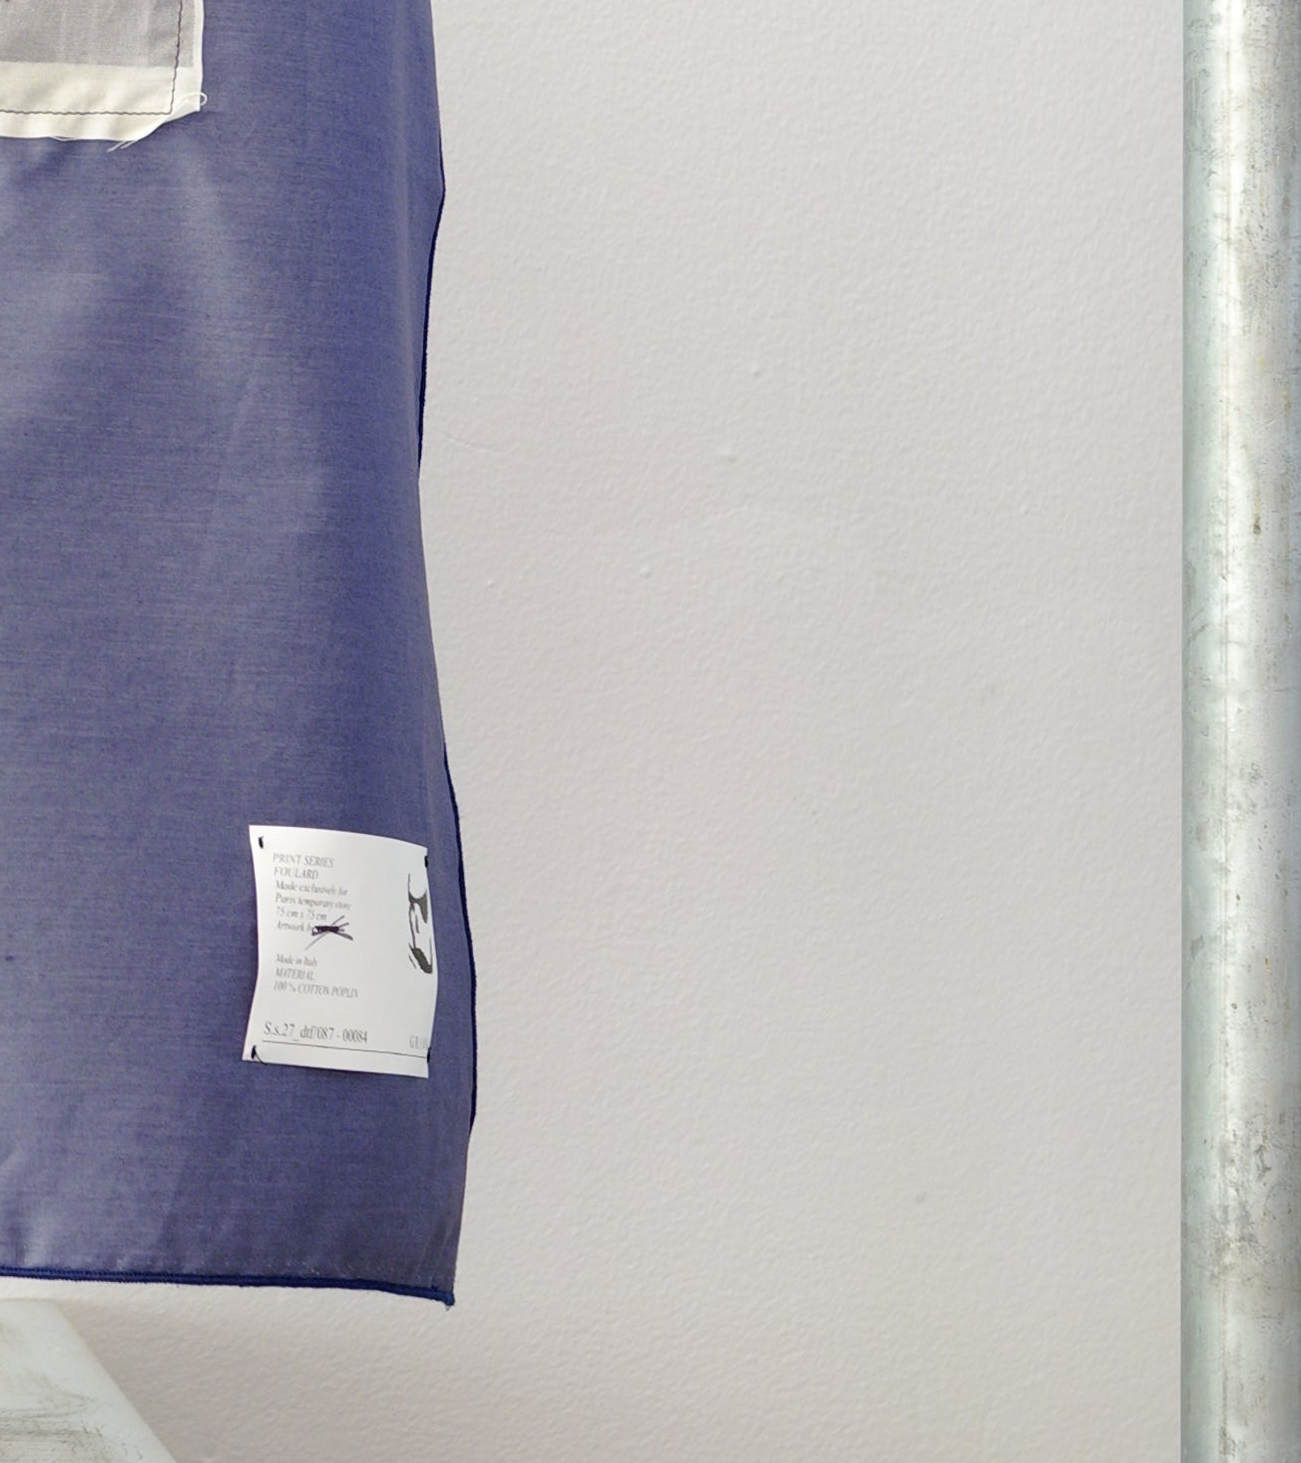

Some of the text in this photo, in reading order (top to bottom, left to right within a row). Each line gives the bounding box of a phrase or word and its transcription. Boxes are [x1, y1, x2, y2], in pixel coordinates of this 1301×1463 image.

[272, 853, 334, 868] PRINT SERIES
[274, 866, 319, 880] FOULARD
[275, 892, 296, 904] Paris
[297, 983, 330, 996] COTTON
[331, 986, 359, 999] POPLIN
